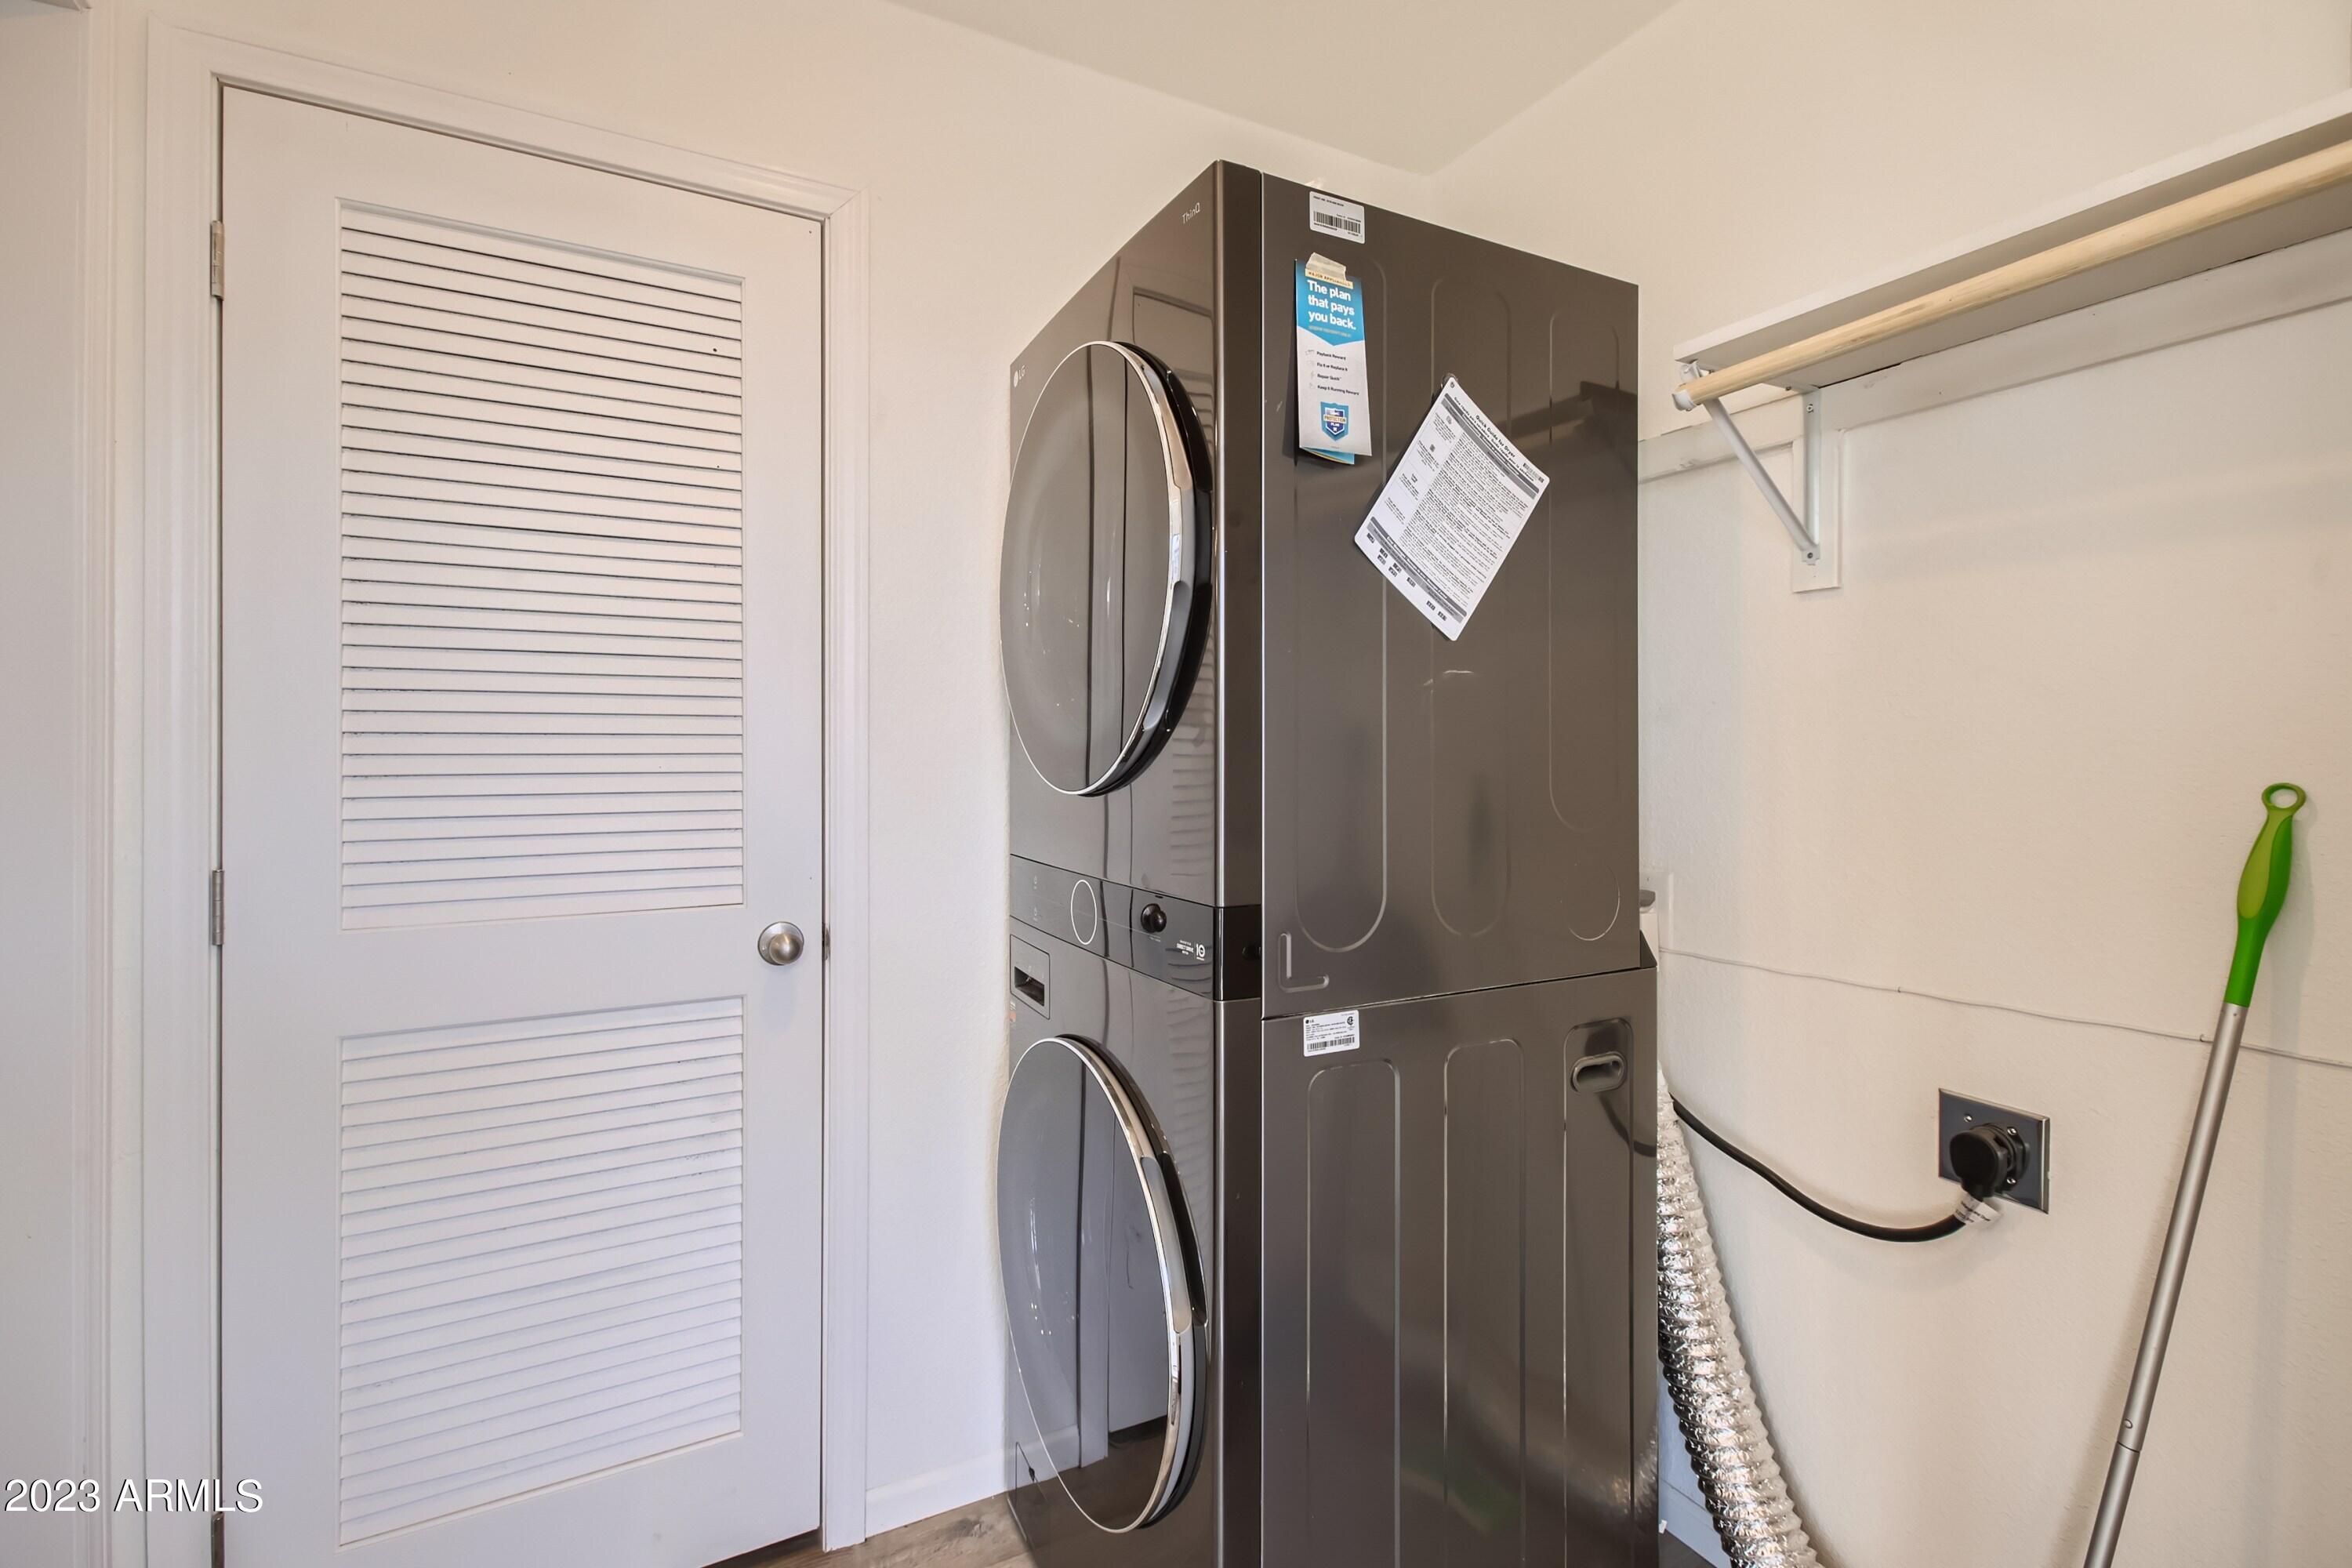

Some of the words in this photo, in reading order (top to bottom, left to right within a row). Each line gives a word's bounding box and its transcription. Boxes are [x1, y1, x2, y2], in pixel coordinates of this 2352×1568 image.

[1182, 202, 1200, 224] ThinQ
[1307, 279, 1327, 295] The
[1330, 287, 1352, 302] plan
[1308, 295, 1329, 309] that
[1330, 302, 1355, 316] pays
[1308, 311, 1328, 323] you
[1330, 314, 1356, 330] back.
[1018, 365, 1025, 380] LG
[1475, 415, 1486, 427] Quick
[1487, 427, 1497, 440] Guide
[1504, 445, 1515, 457] Dryer
